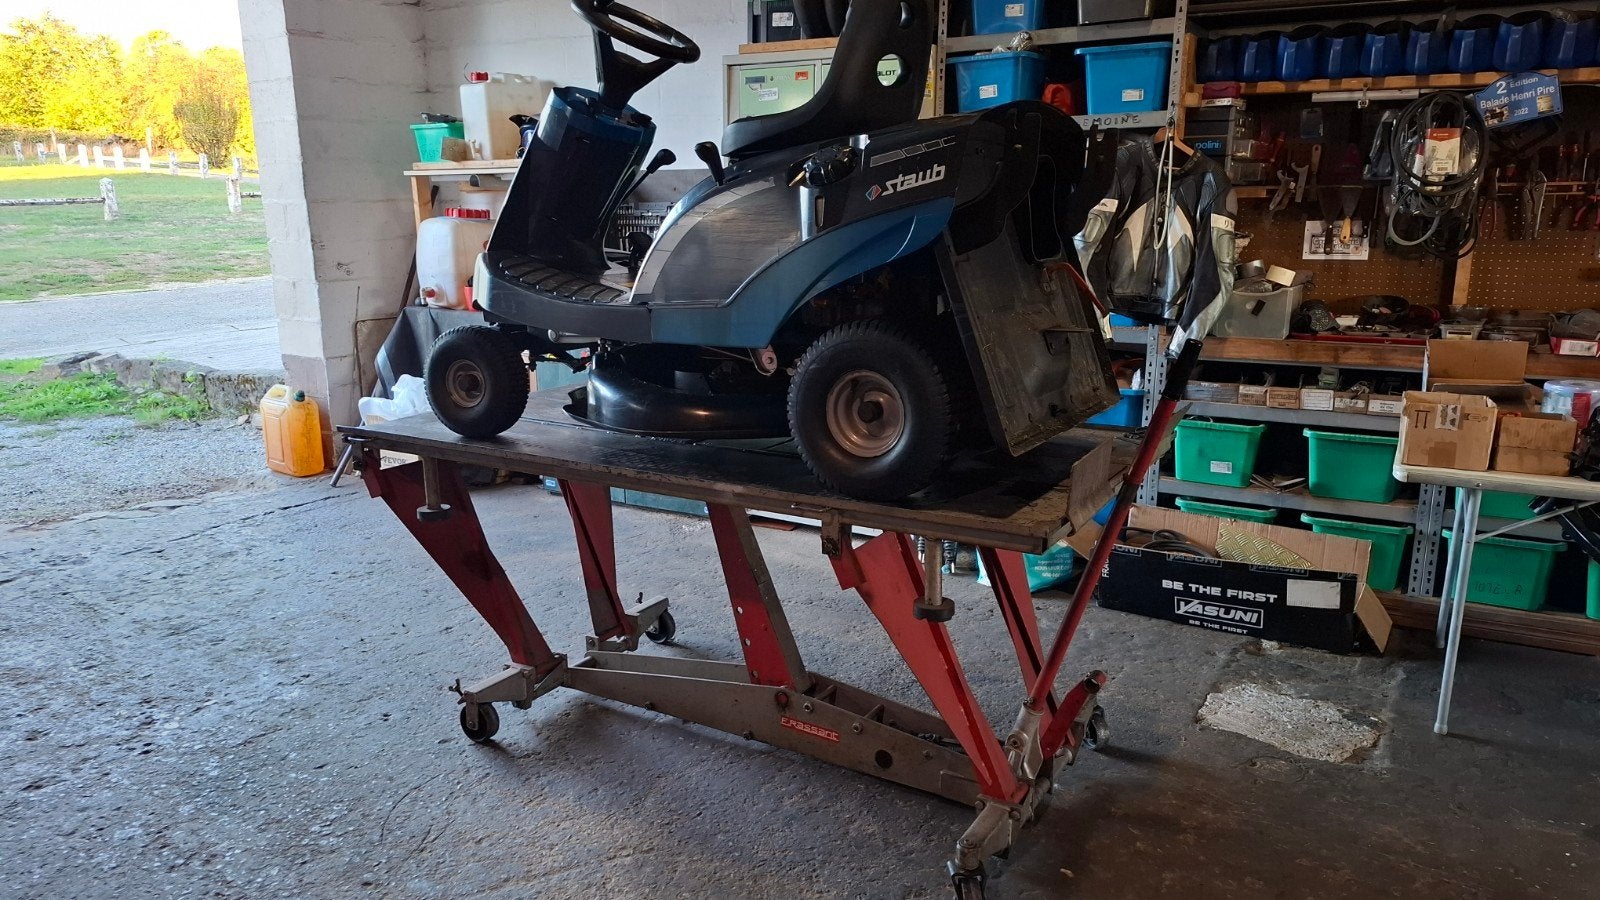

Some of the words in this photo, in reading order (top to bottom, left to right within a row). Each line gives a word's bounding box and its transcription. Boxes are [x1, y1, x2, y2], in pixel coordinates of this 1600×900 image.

[1480, 97, 1510, 109] Balade
[1511, 89, 1535, 101] Henri
[1537, 85, 1555, 96] Pire
[1496, 81, 1507, 95] 2
[1510, 77, 1538, 88] Edition
[1513, 108, 1529, 116] 2022
[881, 163, 946, 197] staub
[1161, 579, 1184, 591] BE
[1188, 583, 1222, 597] THE
[1226, 589, 1278, 603] FIRST
[1179, 600, 1259, 624] YASUNI
[1202, 622, 1220, 630] THE
[1222, 625, 1248, 635] FIRST
